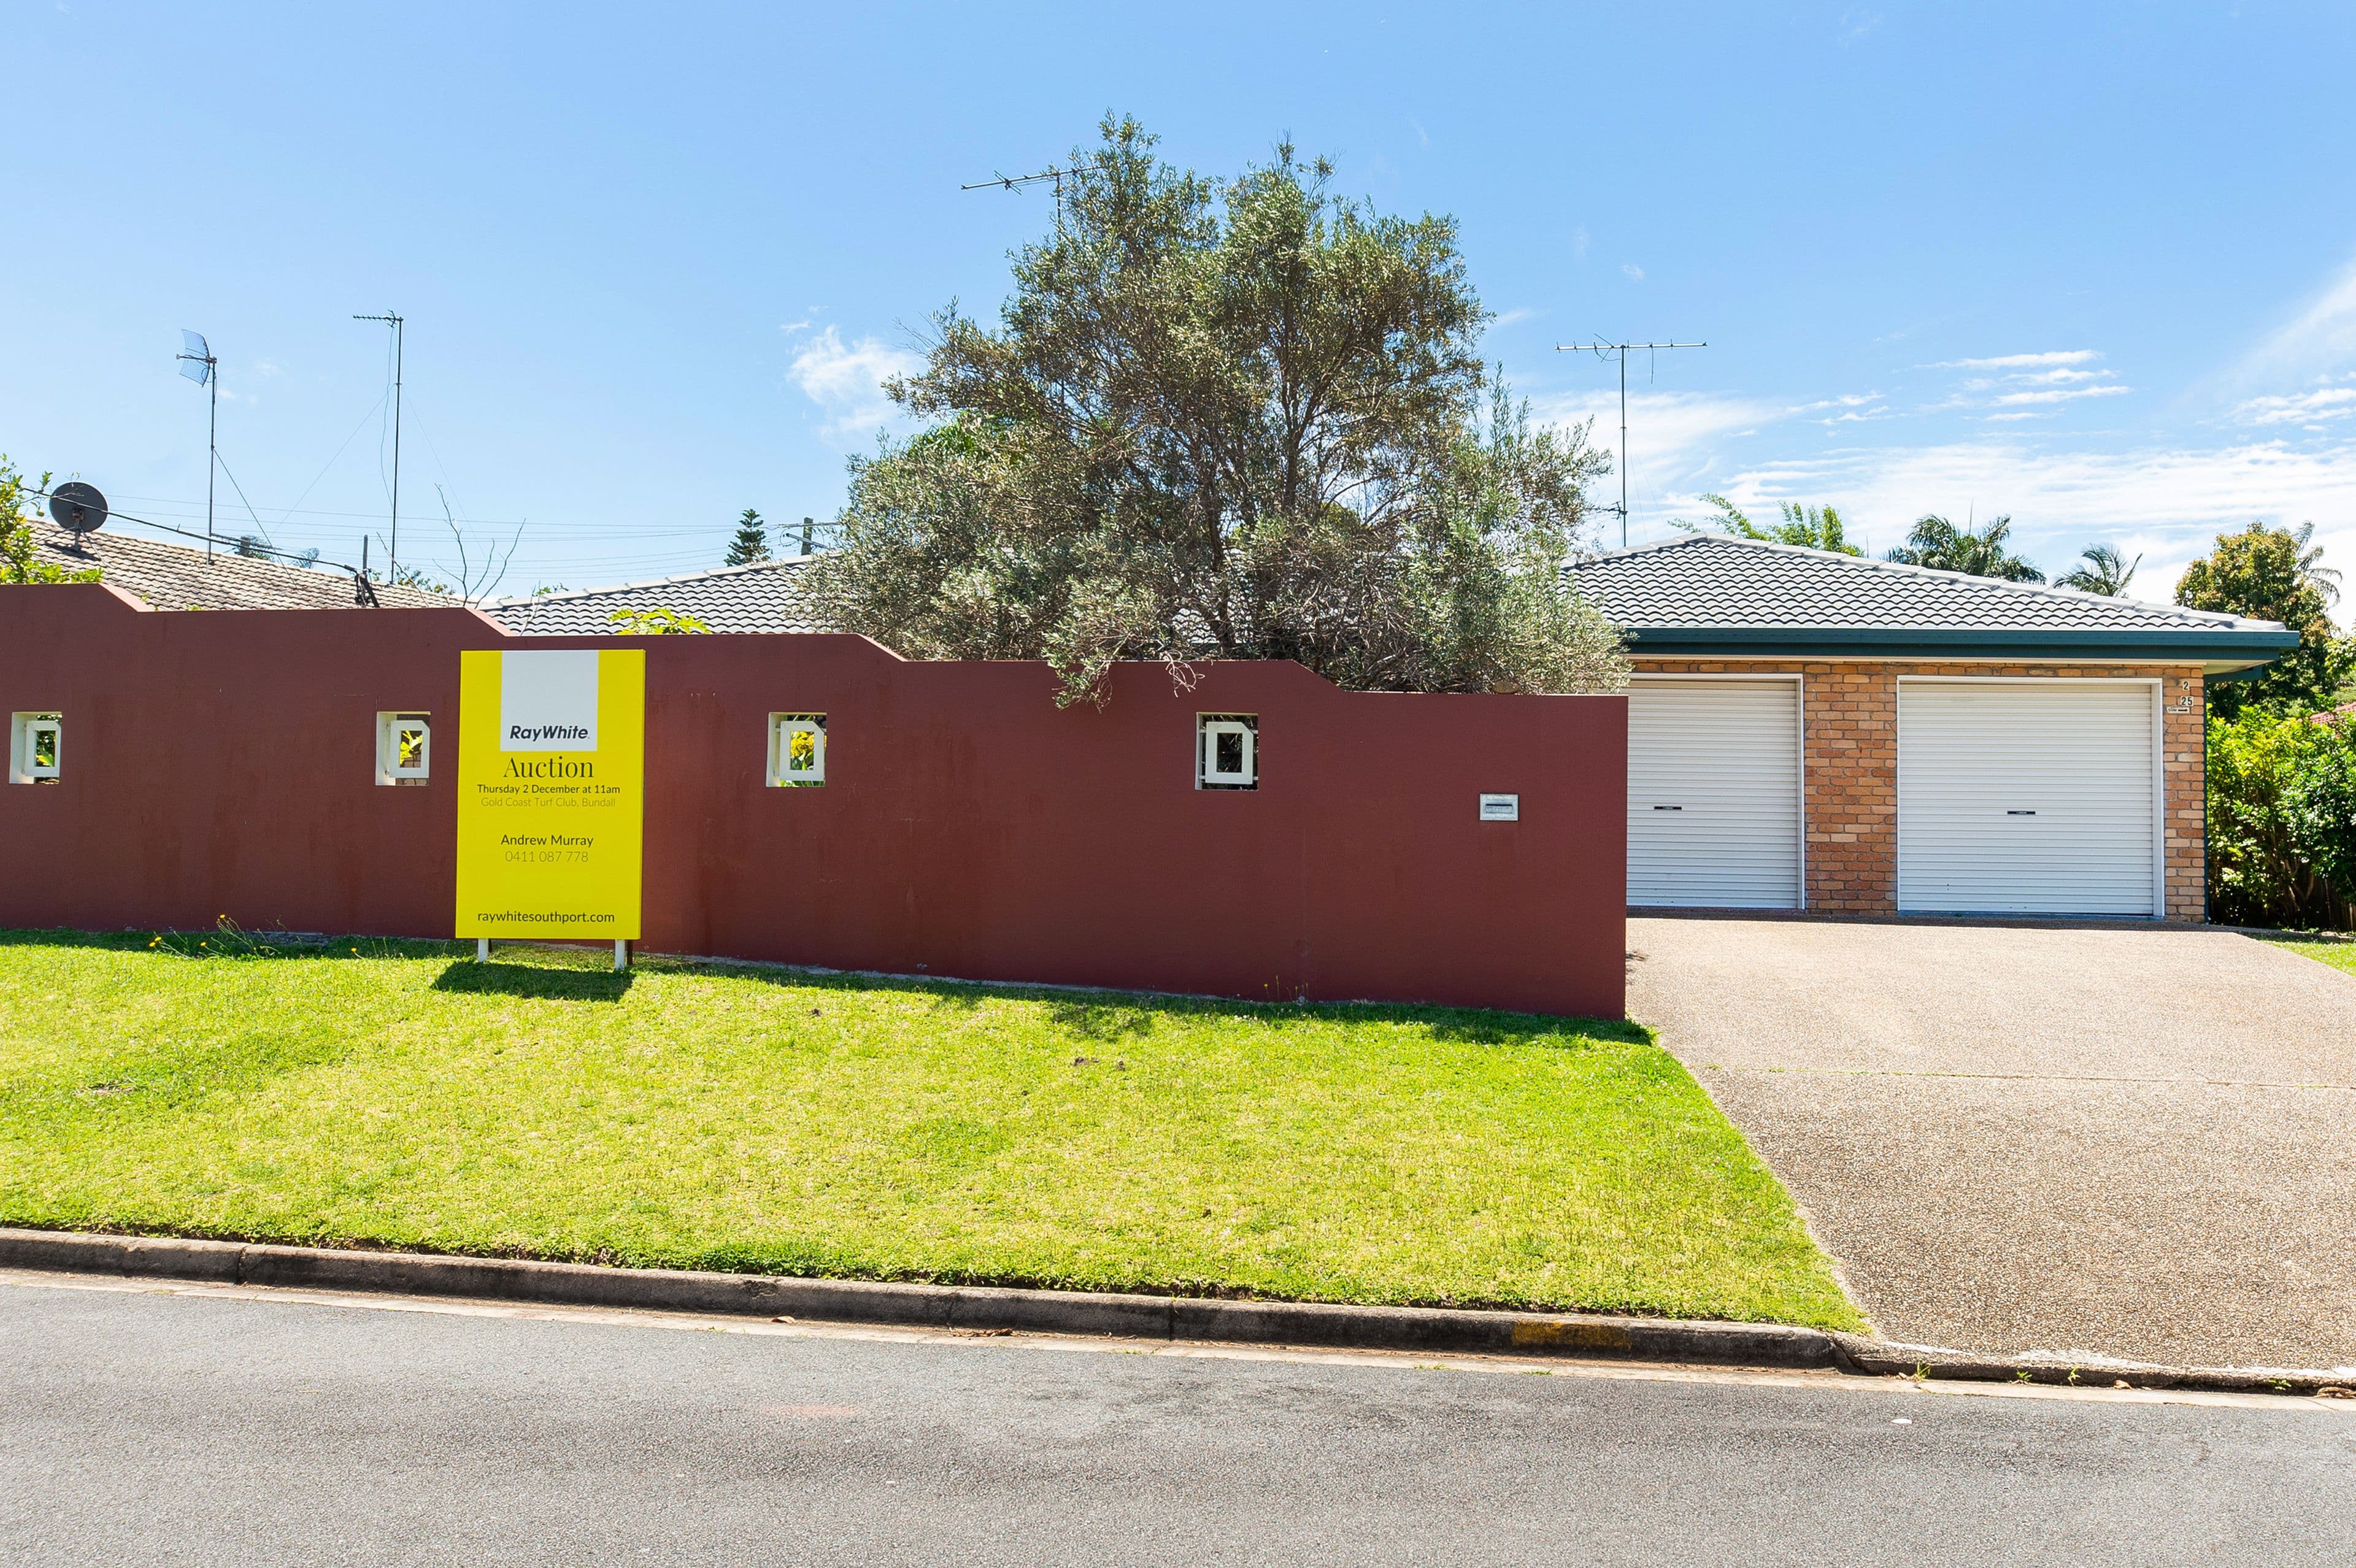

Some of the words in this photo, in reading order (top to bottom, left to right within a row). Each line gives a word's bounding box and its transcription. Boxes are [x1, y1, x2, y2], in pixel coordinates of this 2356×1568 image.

[2183, 681, 2189, 690] 2
[2181, 696, 2192, 705] 25
[503, 756, 594, 778] Auction
[477, 784, 520, 794] Thursday
[523, 785, 528, 793] 2
[532, 785, 580, 794] December
[595, 785, 620, 794] 11am
[481, 797, 502, 807] Gold
[506, 797, 531, 807] Coast
[535, 797, 553, 807] Turf
[556, 797, 579, 807] Club,
[582, 797, 616, 807] Bundall
[501, 834, 547, 845] Andrew
[551, 834, 594, 848] Murray
[505, 851, 535, 862] 0411
[539, 851, 563, 862] 087
[566, 851, 589, 863] 778
[477, 910, 615, 924] raywhitesouthport.com
